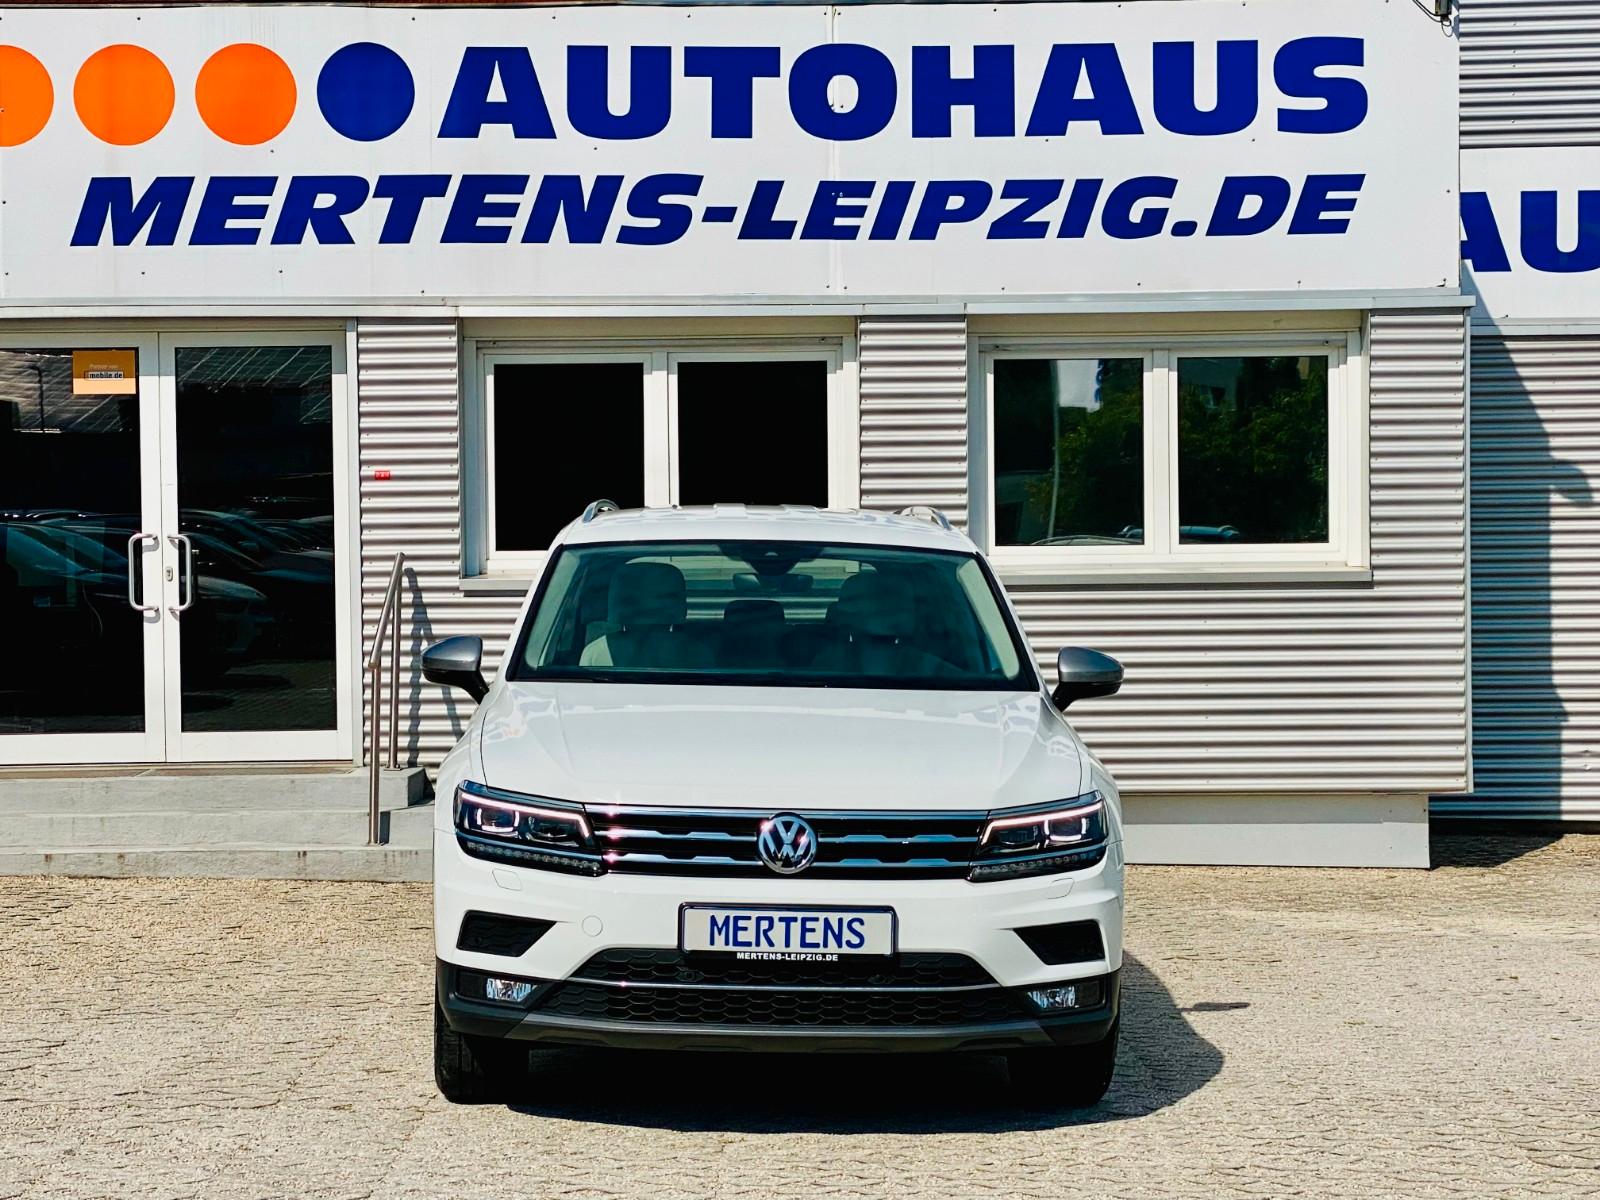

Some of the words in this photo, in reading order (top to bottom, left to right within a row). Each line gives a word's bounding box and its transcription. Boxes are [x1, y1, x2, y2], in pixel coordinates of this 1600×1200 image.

[439, 37, 1369, 141] AUTOHAUS
[71, 173, 1365, 246] MERTENS-LEIPZIG.DE
[709, 914, 865, 949] MERTENS
[736, 951, 839, 962] MERTENS-LEIPZIG.DE
